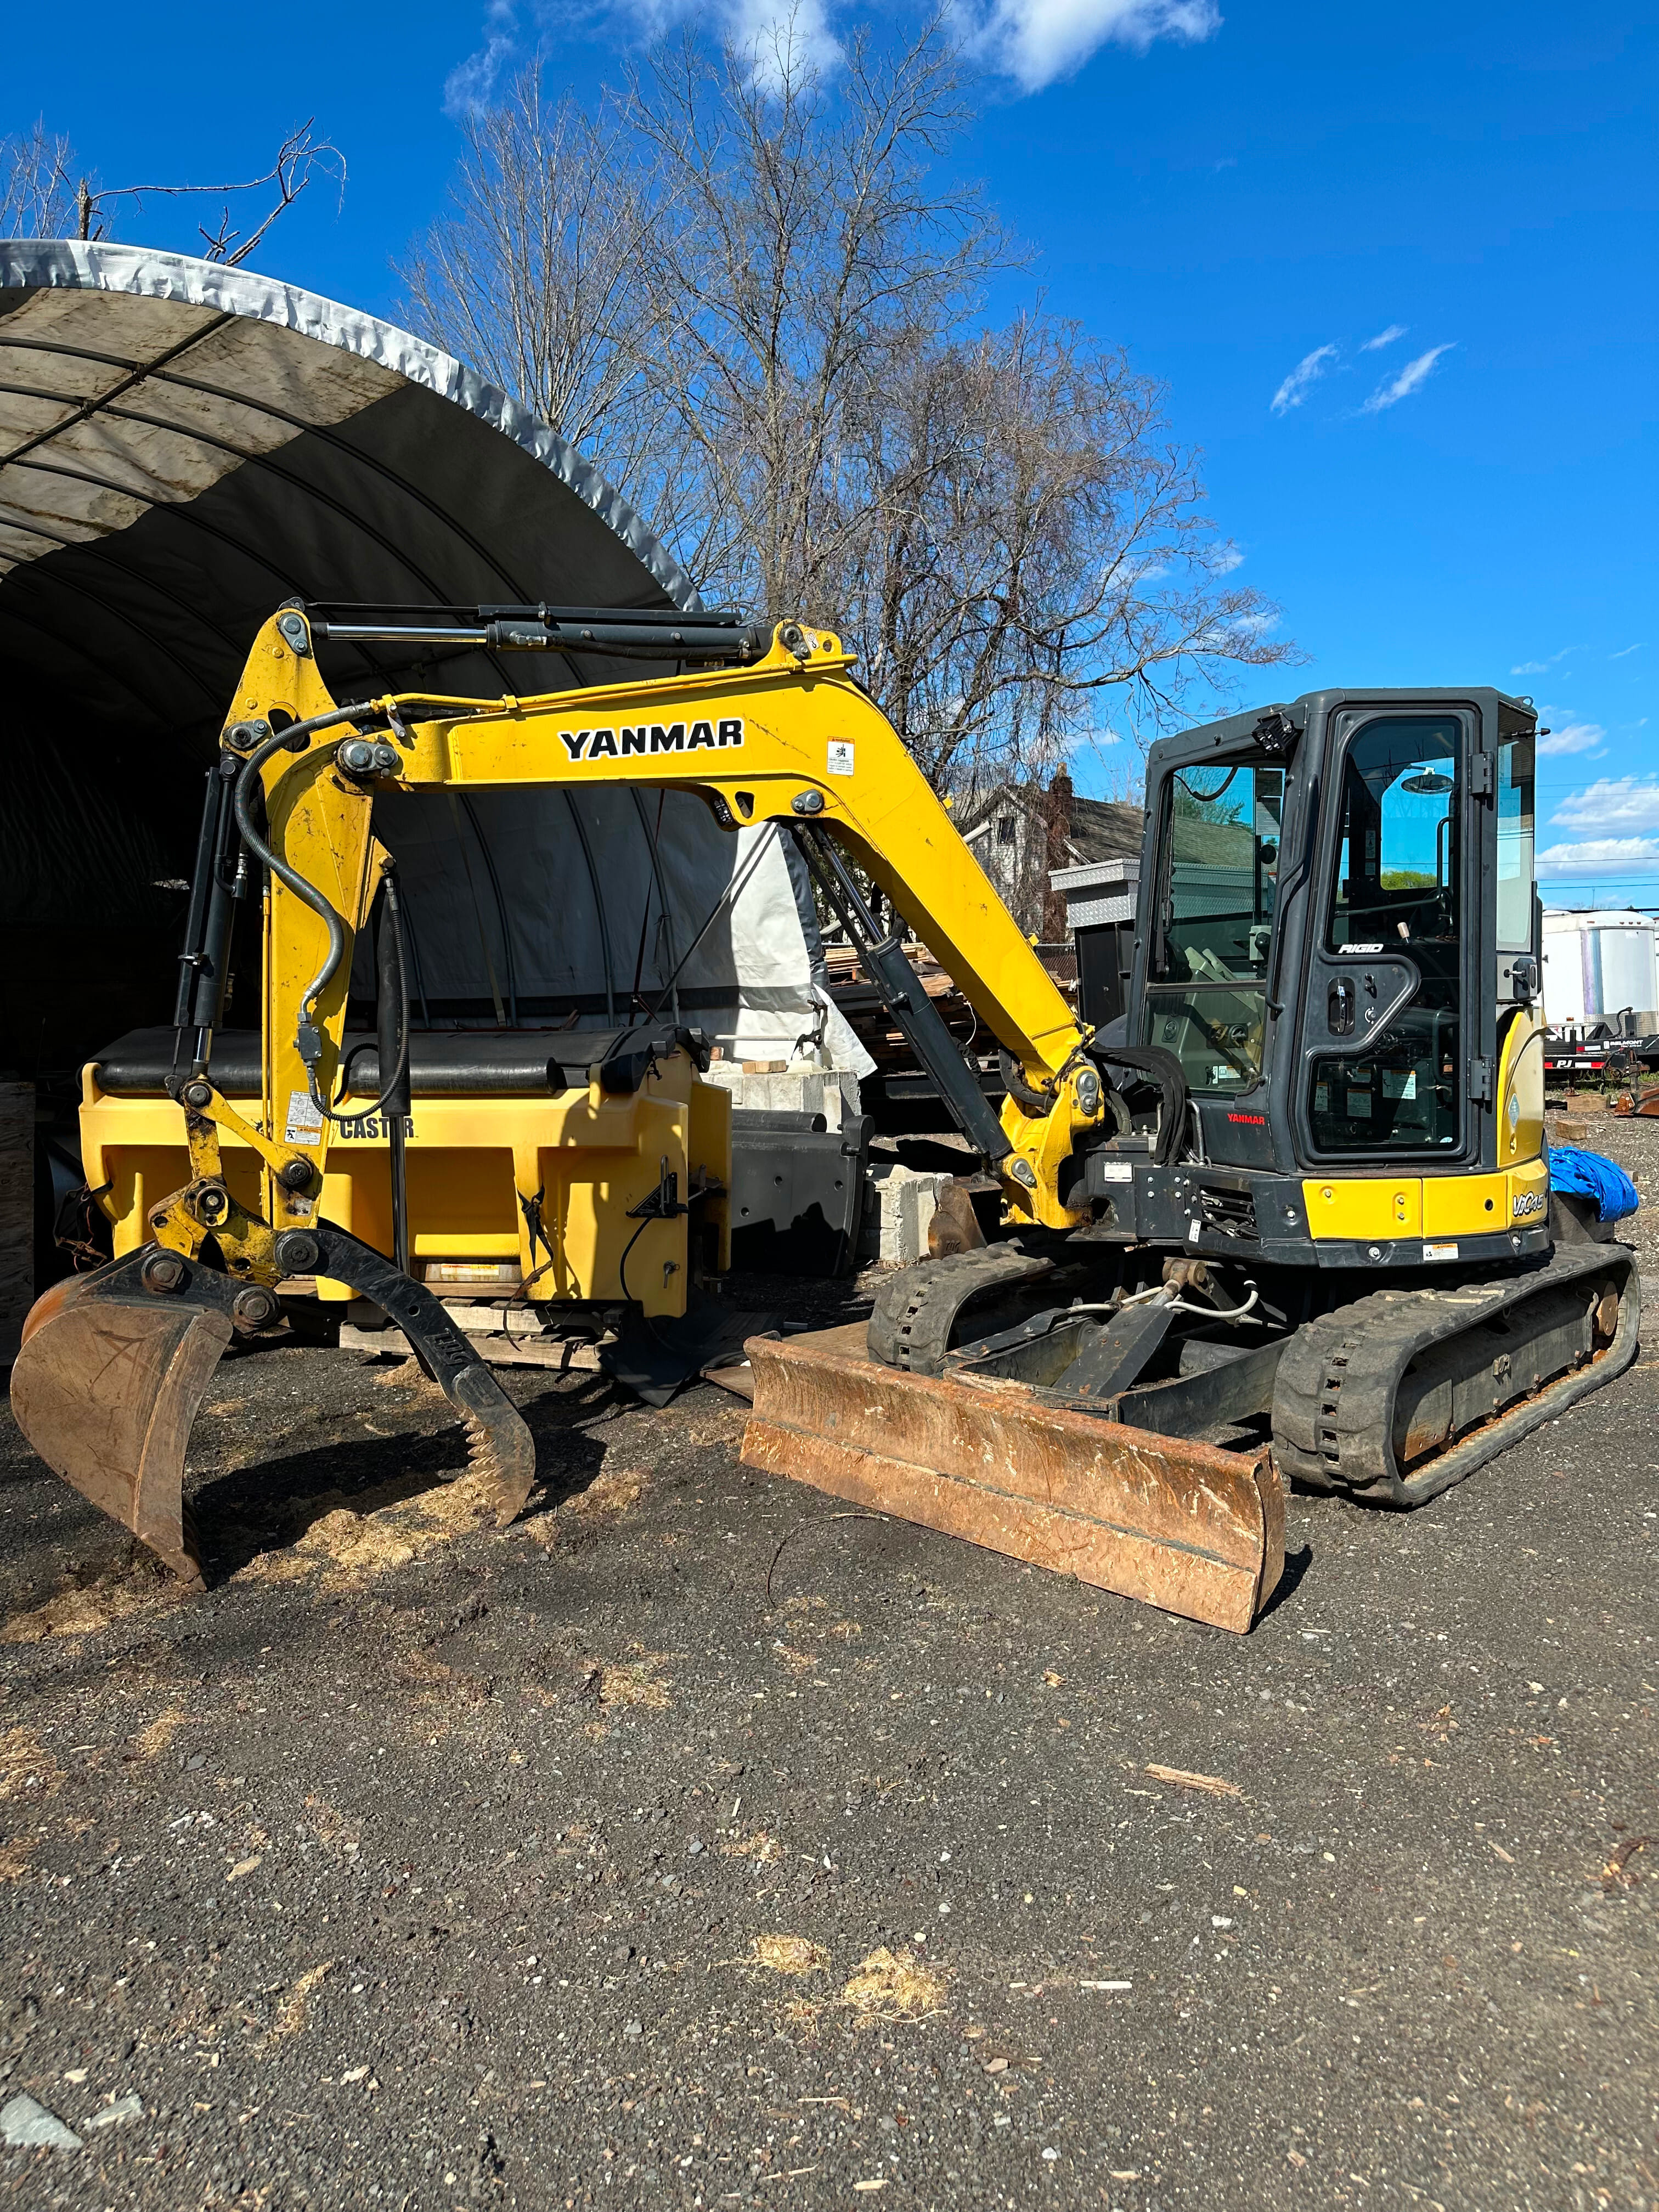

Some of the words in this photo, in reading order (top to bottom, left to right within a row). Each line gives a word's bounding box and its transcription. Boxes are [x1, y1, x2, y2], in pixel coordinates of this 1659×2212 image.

[560, 719, 742, 759] YANMAR
[1338, 944, 1384, 953] RIGID
[1556, 1059, 1572, 1068] PJ
[1227, 1113, 1265, 1126] YANMAR
[340, 1117, 414, 1139] CASTR
